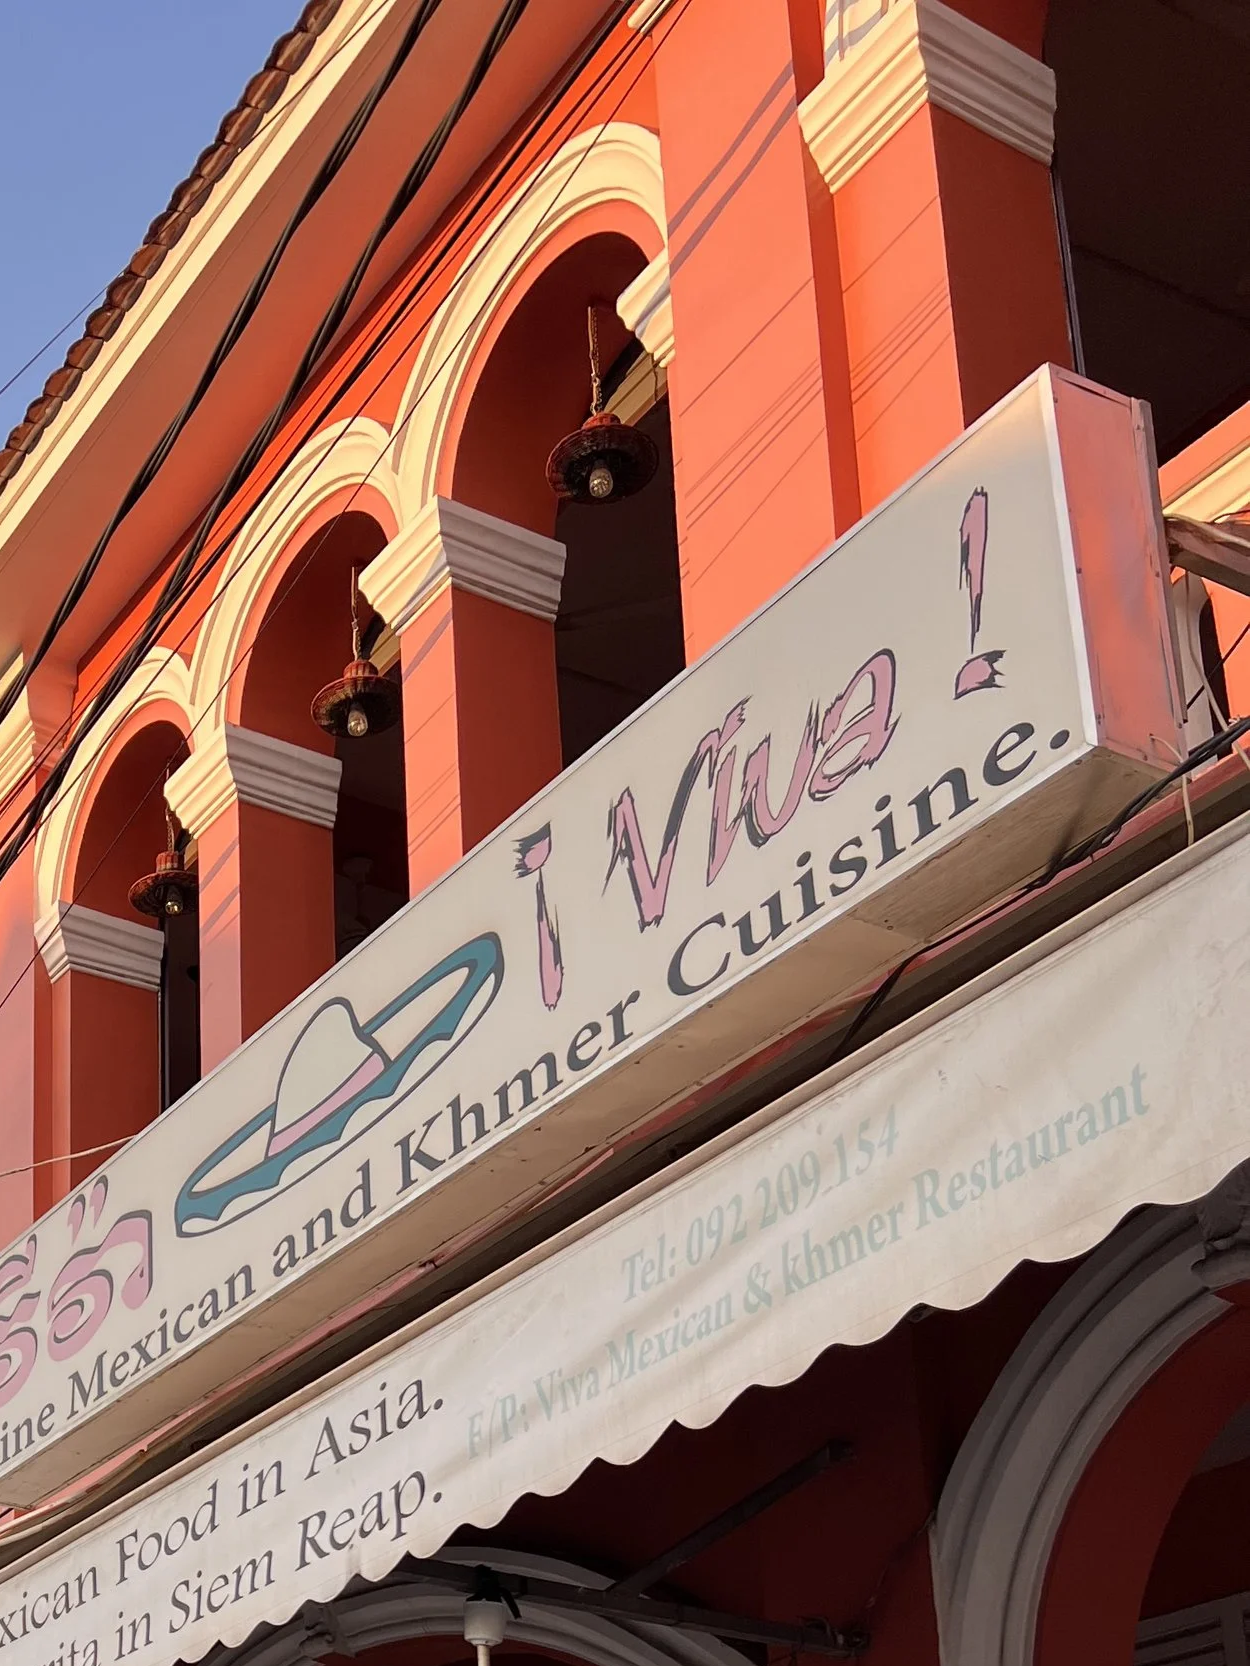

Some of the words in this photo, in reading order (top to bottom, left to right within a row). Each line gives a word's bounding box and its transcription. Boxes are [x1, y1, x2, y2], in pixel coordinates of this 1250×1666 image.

[602, 648, 903, 934] Viva
[66, 1263, 257, 1421] Mexican
[272, 1159, 378, 1278] and
[394, 990, 641, 1197] Khmer
[666, 721, 1071, 996] Cuisine.
[533, 1366, 601, 1422] Viva
[604, 1293, 735, 1391] Mexican
[742, 1260, 774, 1315] &
[780, 1201, 905, 1298] khmer
[912, 1062, 1151, 1232] Restaurant
[622, 1230, 678, 1304] Tel:
[685, 1193, 749, 1268] 092
[758, 1150, 823, 1231] 209
[831, 1104, 900, 1188] 154
[114, 1611, 154, 1662] in
[169, 1549, 276, 1634] Siem
[294, 1470, 443, 1572] Reap.
[115, 1478, 220, 1586] Food
[237, 1459, 286, 1518] in
[304, 1378, 444, 1481] Asia.
